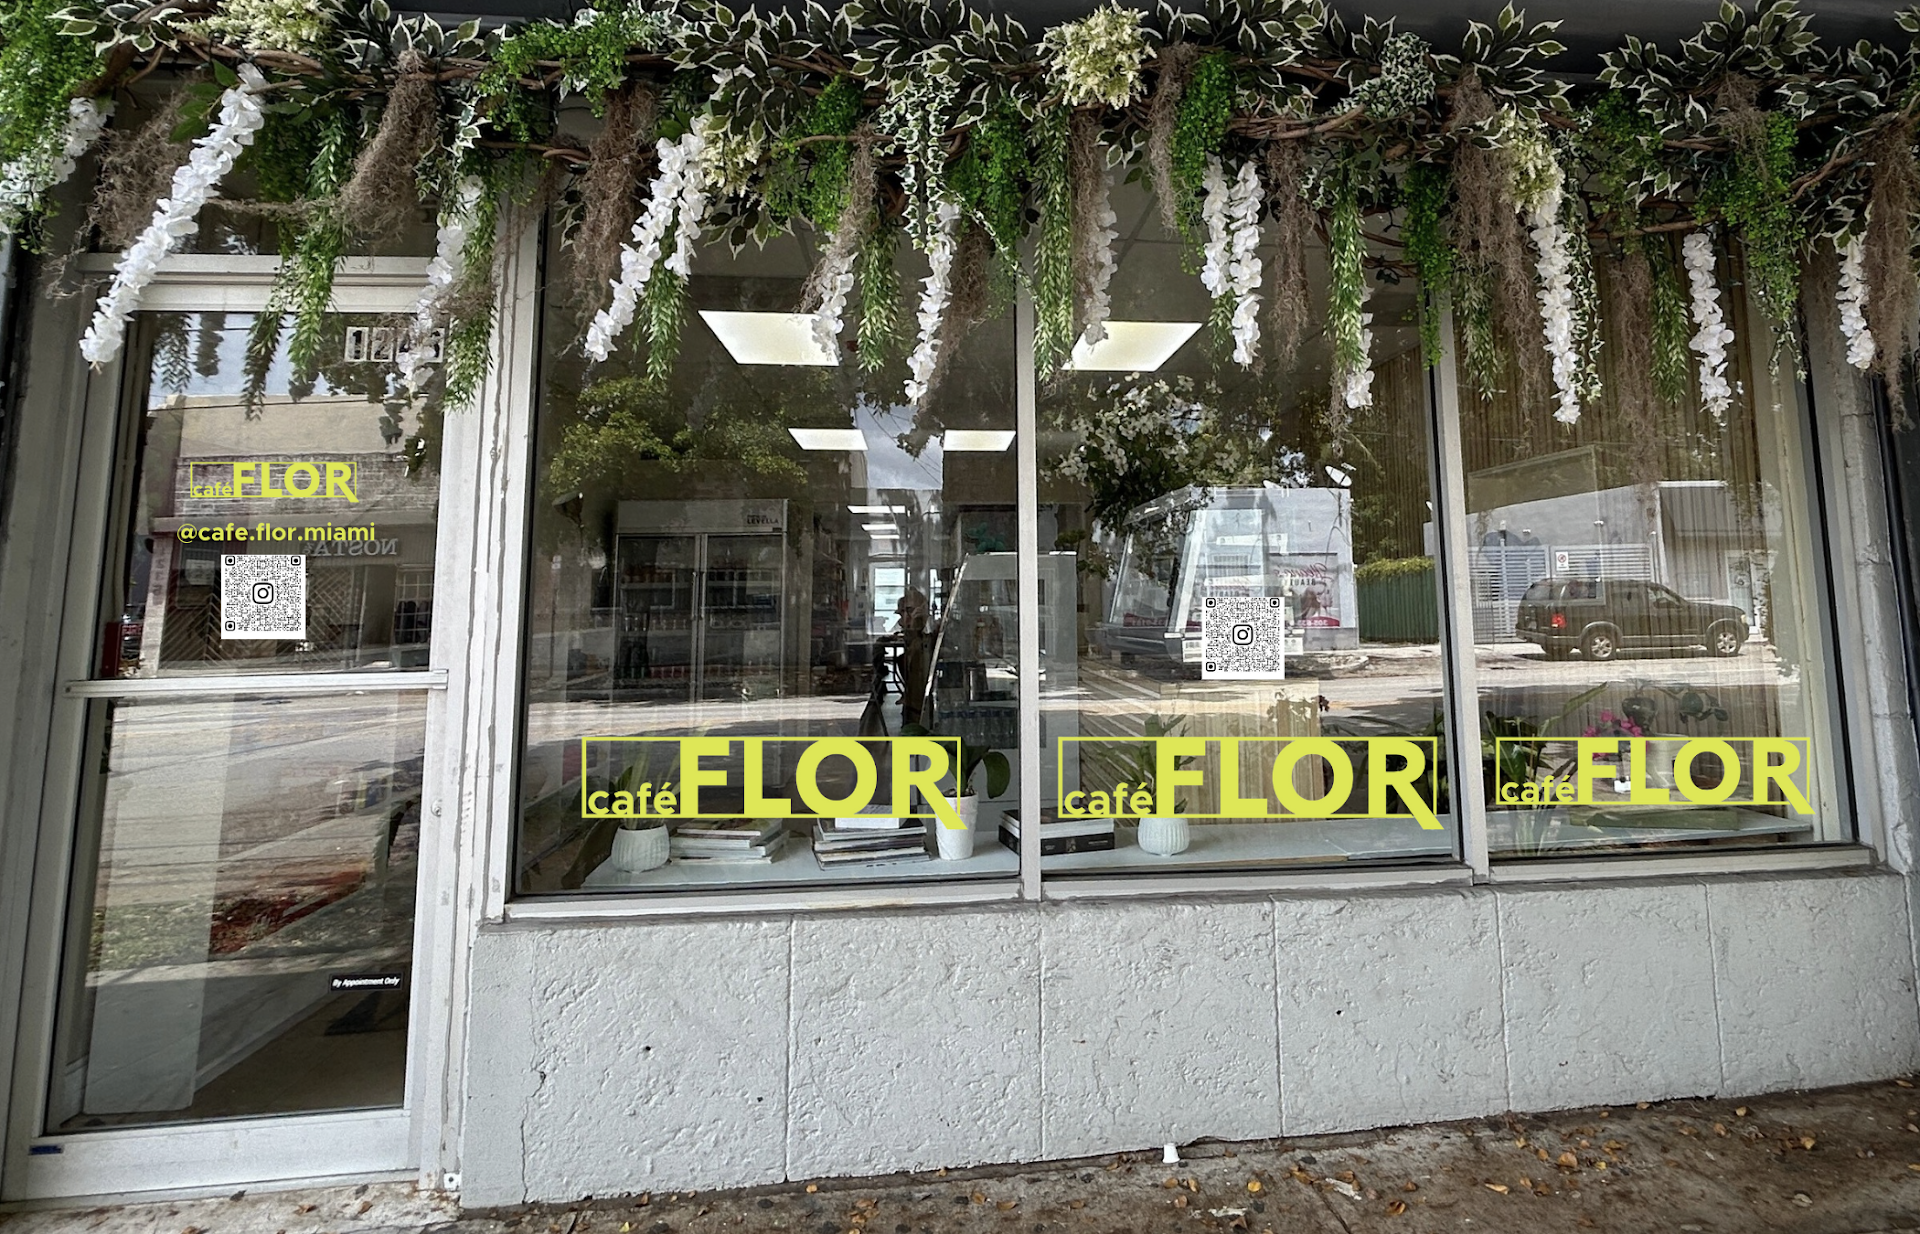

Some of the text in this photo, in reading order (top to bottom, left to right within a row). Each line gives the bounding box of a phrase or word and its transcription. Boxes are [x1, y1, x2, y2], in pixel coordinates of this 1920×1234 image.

[193, 462, 360, 503] café FLOR
[177, 522, 376, 544] @cafe.flor.miami
[588, 737, 968, 830] café FLOR
[1064, 737, 1444, 830] café FLOR
[1501, 737, 1816, 815] café FLOR
[342, 978, 383, 987] Appointment
[384, 977, 400, 985] Only
